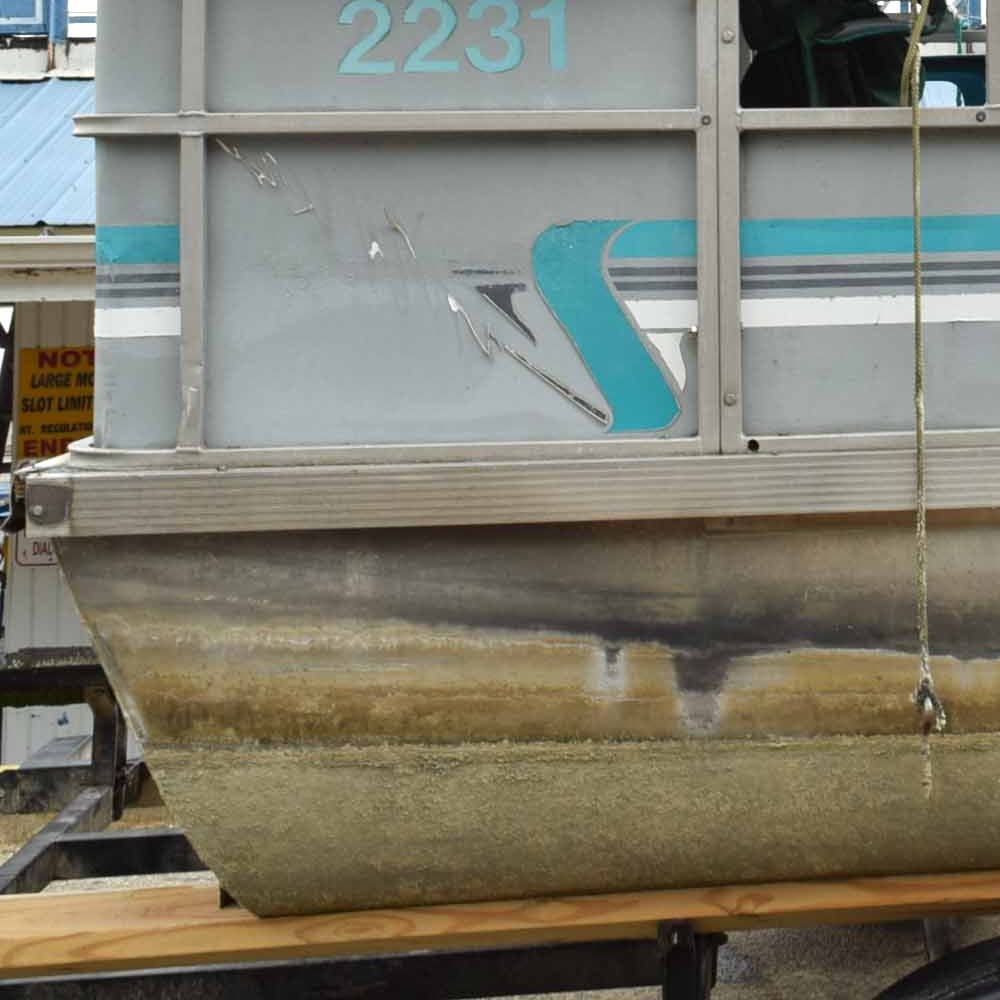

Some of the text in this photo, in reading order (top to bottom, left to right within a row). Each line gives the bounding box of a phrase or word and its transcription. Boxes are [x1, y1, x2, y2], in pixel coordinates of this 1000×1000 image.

[31, 372, 72, 389] LARGE
[21, 395, 94, 412] SLOT LIMIT
